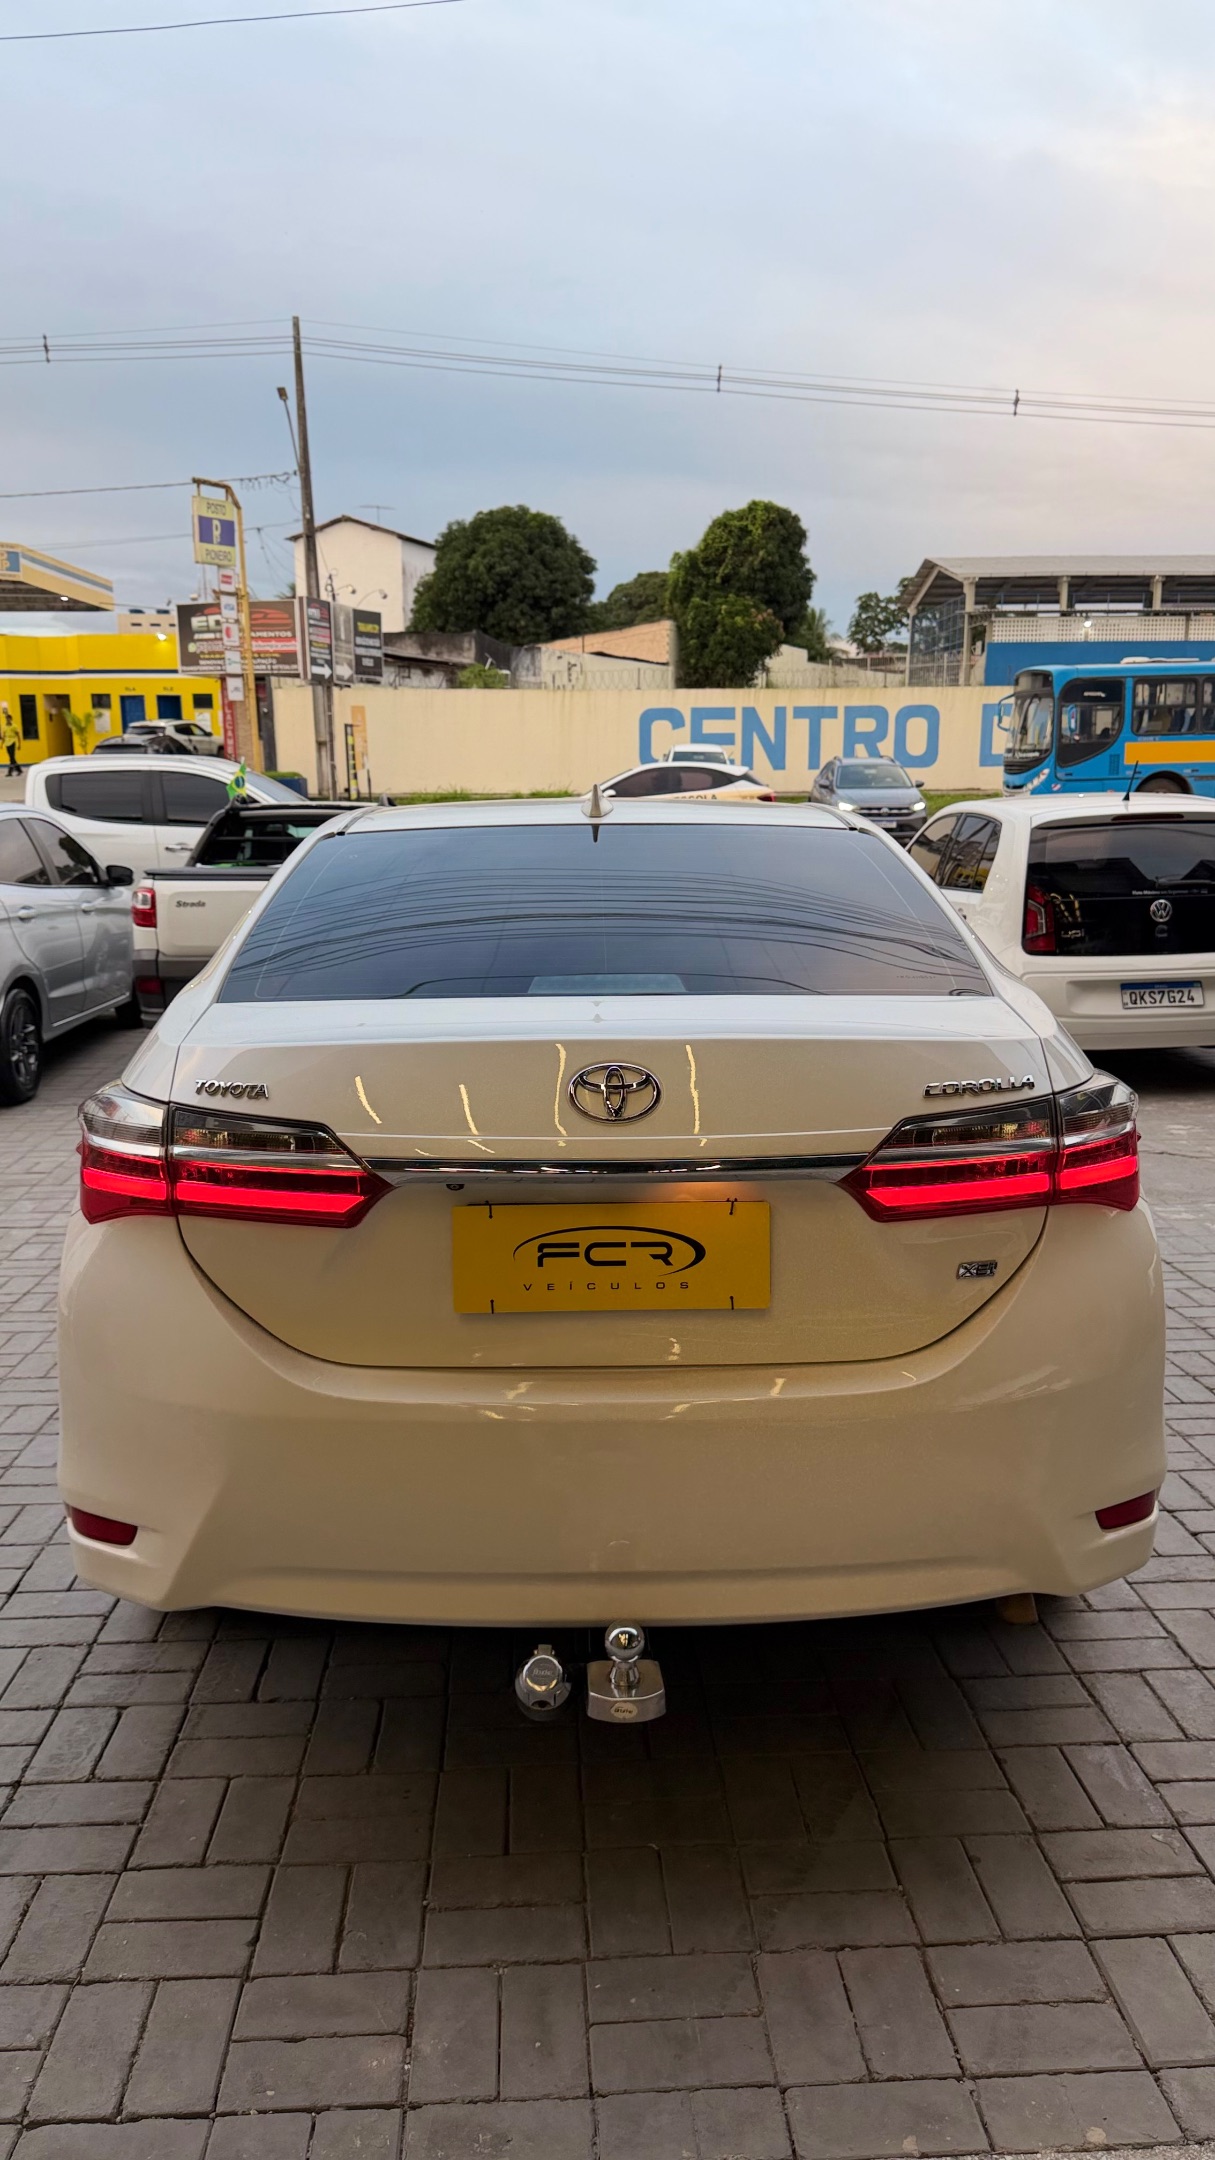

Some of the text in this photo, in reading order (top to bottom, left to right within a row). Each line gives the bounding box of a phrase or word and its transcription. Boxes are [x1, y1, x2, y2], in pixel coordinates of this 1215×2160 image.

[639, 705, 940, 770] CENTRO
[175, 900, 206, 908] Strada
[1129, 989, 1195, 1006] QKS7G24
[195, 1079, 269, 1099] TOYOTA
[923, 1074, 1035, 1098] COROLLA
[537, 1241, 674, 1267] FCR
[523, 1281, 689, 1291] VEÍCULOS
